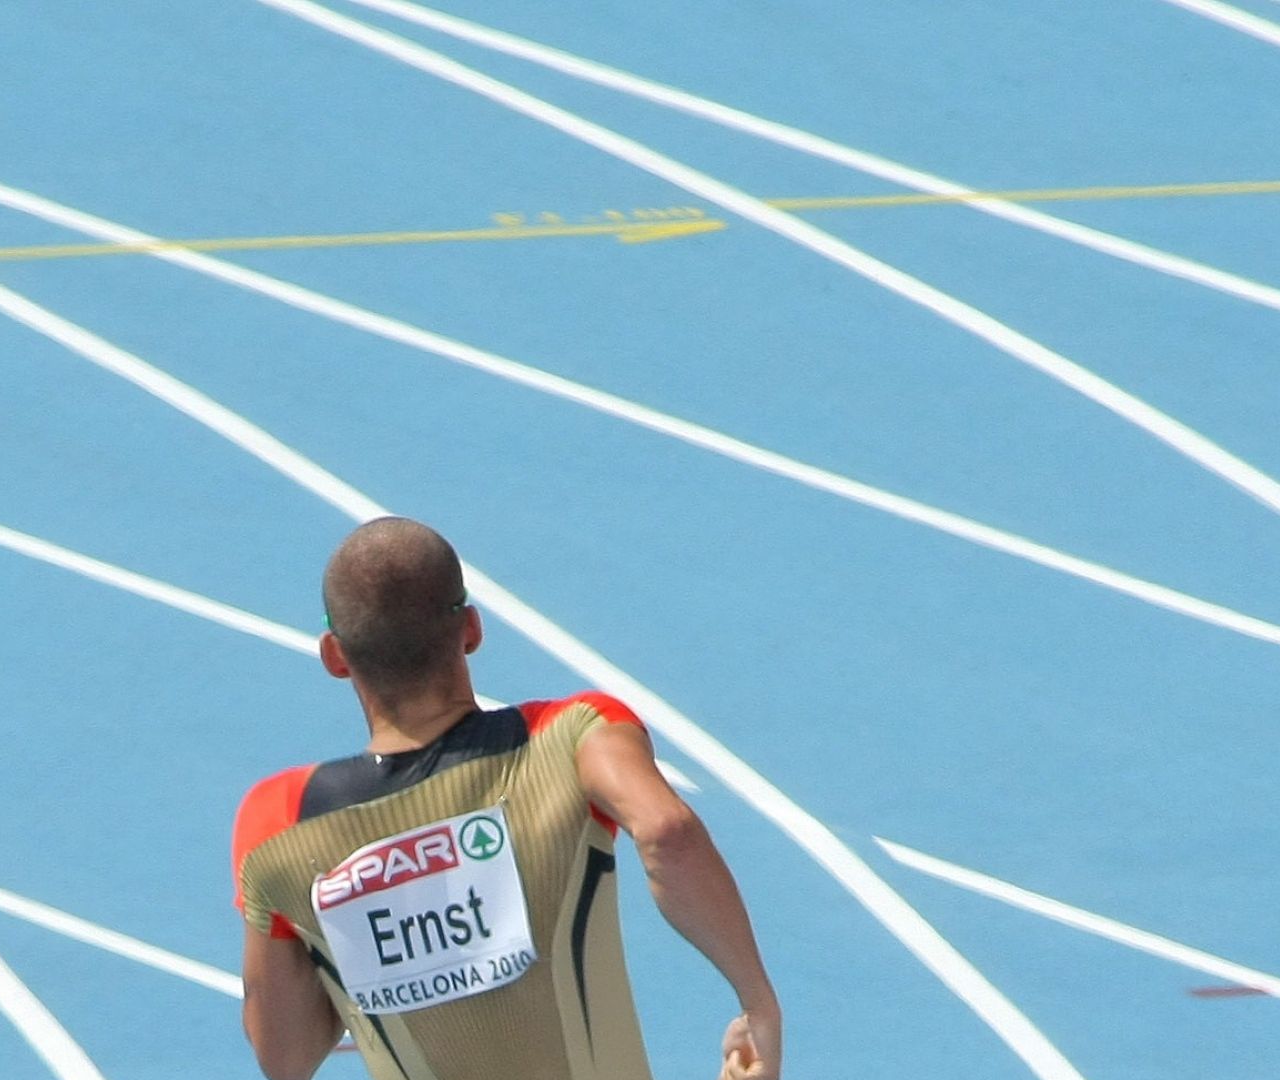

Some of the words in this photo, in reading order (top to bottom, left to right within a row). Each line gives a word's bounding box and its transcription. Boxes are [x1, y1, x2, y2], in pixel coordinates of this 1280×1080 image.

[320, 834, 454, 905] SPAR
[367, 884, 491, 967] Ernst
[356, 965, 484, 1010] BARCELONA
[487, 950, 532, 981] 2010
